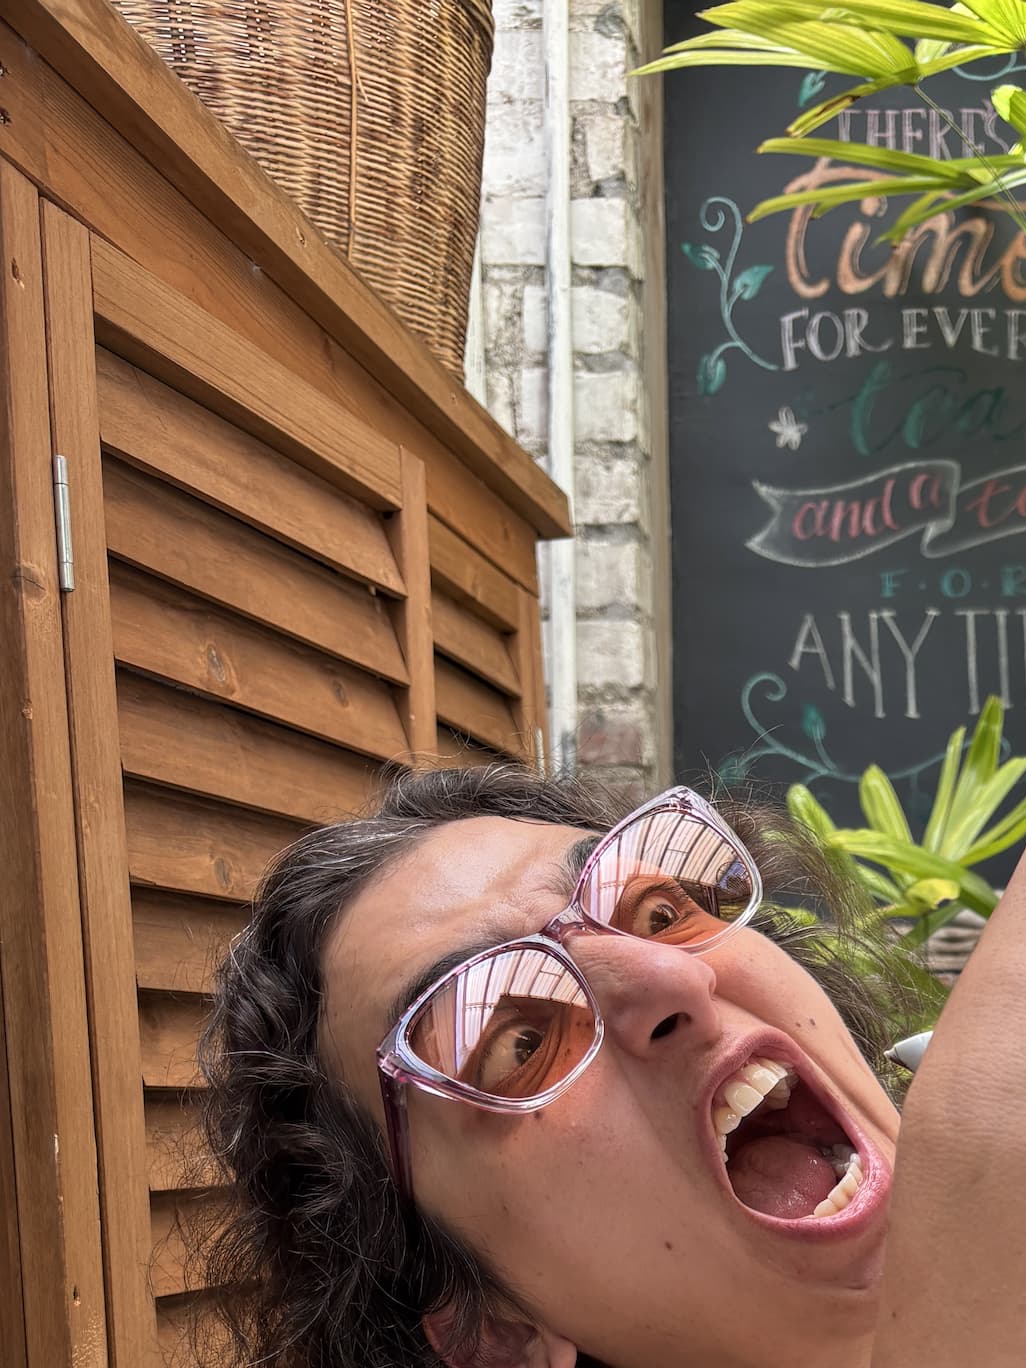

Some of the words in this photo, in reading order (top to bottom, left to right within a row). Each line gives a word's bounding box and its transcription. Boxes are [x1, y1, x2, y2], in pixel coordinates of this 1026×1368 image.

[780, 307, 893, 372] FOR
[792, 479, 901, 542] and
[909, 472, 944, 510] a
[789, 607, 940, 719] ANY
